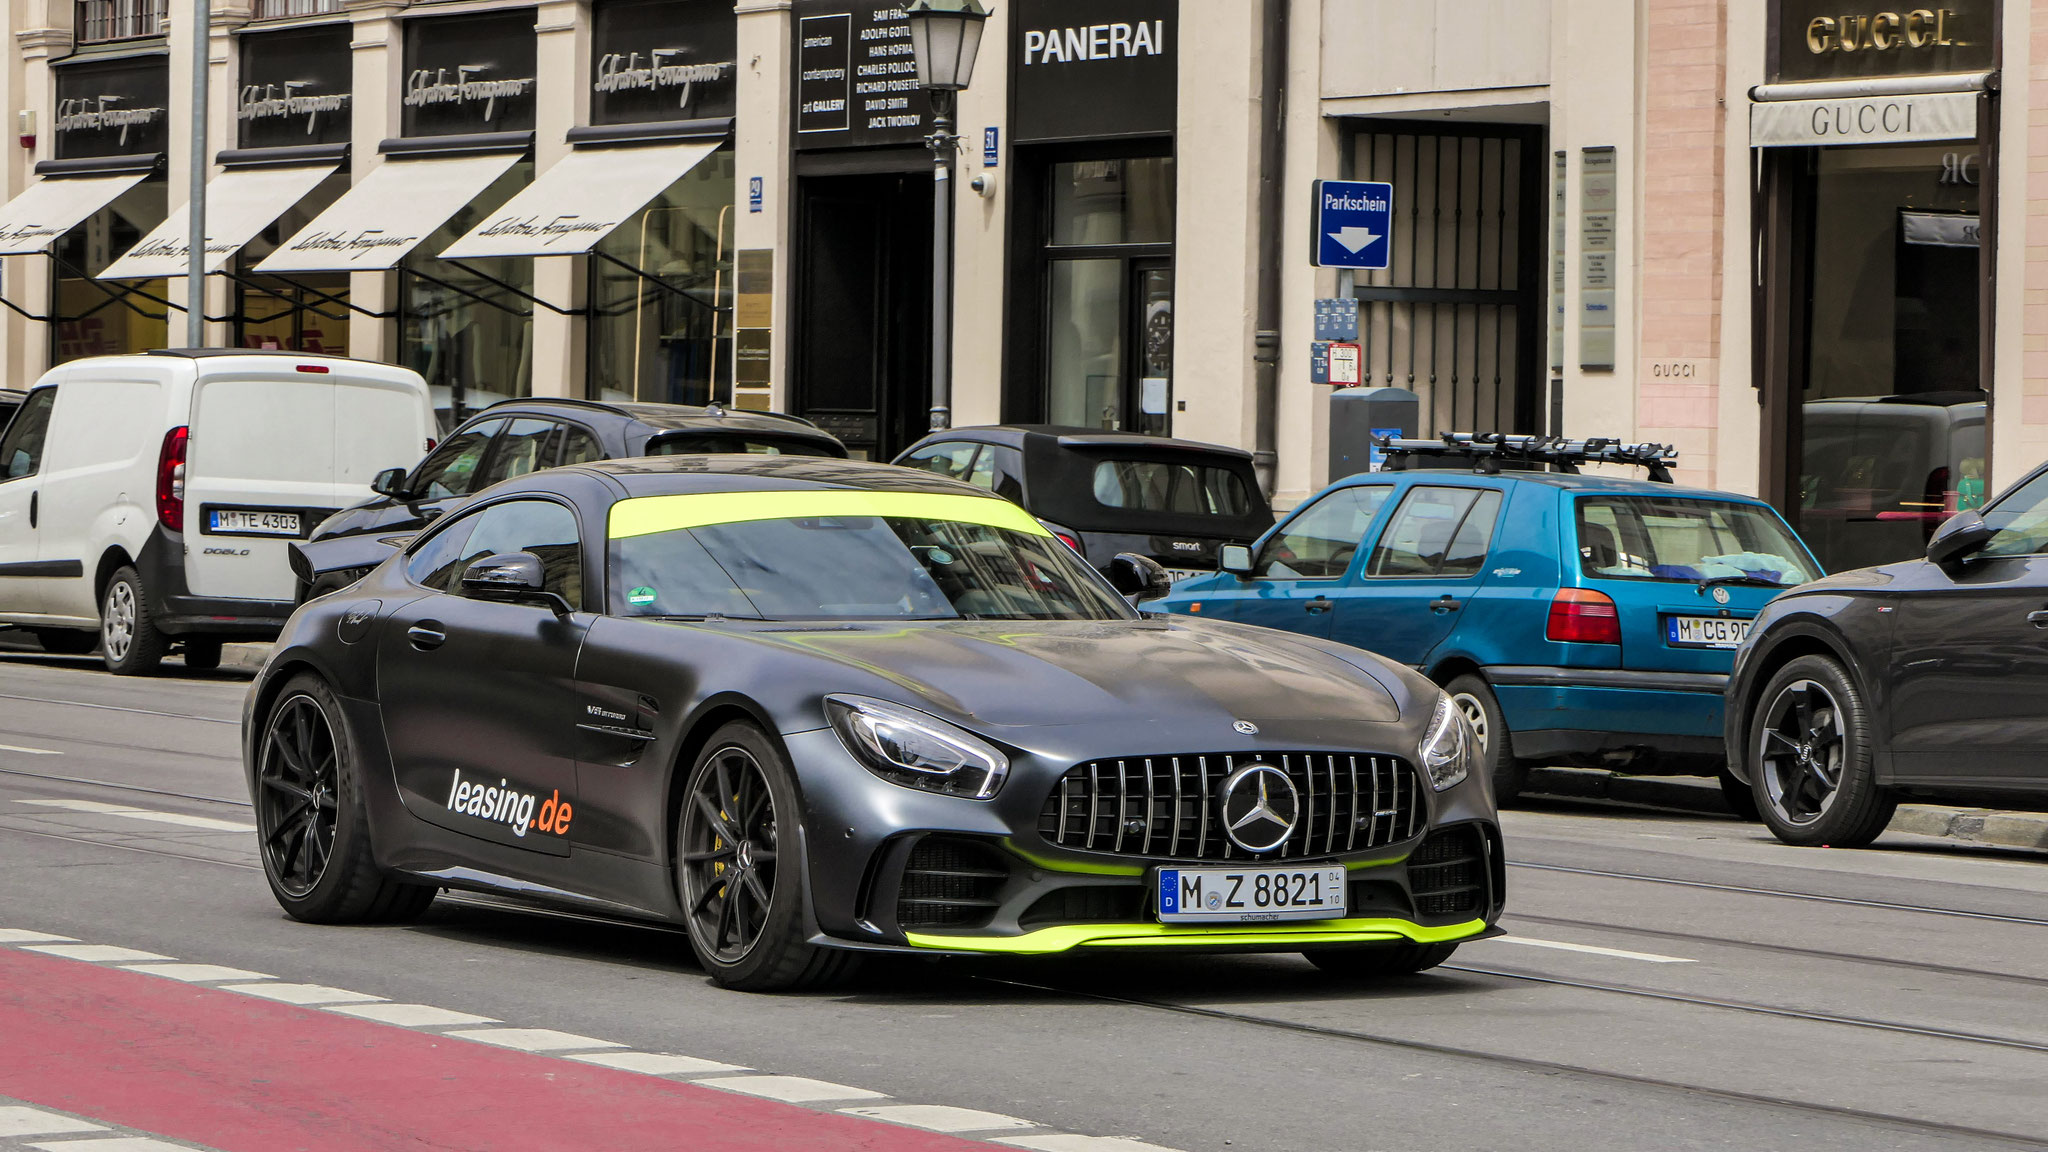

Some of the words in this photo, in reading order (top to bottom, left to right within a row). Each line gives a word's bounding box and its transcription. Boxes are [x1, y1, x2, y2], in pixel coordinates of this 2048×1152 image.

[873, 10, 888, 21] SAM
[860, 28, 887, 40] ADOLPH
[1807, 9, 1952, 54] GUCCI
[803, 35, 832, 48] american
[1025, 20, 1162, 65] PANERAI
[869, 45, 887, 57] HANS
[888, 44, 914, 55] HOFMA
[803, 69, 845, 81] contemporary
[857, 64, 887, 76] CHARLES
[888, 62, 917, 74] POLLOC
[856, 81, 886, 94] RICHARD
[802, 102, 812, 113] art
[813, 100, 845, 112] GALLERY
[865, 100, 886, 111] DAVID
[887, 98, 908, 110] SMITH
[868, 117, 886, 129] JACK
[887, 115, 920, 127] TWORKOV
[1812, 103, 1912, 135] GUCCI
[985, 131, 995, 149] 31
[1325, 194, 1386, 212] Parkschein
[1653, 363, 1695, 377] GUCCI
[219, 512, 229, 527] M
[239, 513, 258, 527] TE
[262, 515, 297, 529] 4303
[1173, 542, 1200, 551] smart
[1680, 620, 1691, 640] M
[1703, 621, 1726, 641] CG
[447, 768, 573, 837] leasing.de
[1329, 872, 1340, 882] 04
[1182, 875, 1202, 908] M
[1225, 875, 1245, 907] Z
[1254, 873, 1323, 908] 8821
[1165, 897, 1173, 907] D
[1329, 894, 1340, 904] 10
[1240, 913, 1279, 921] schumacher
